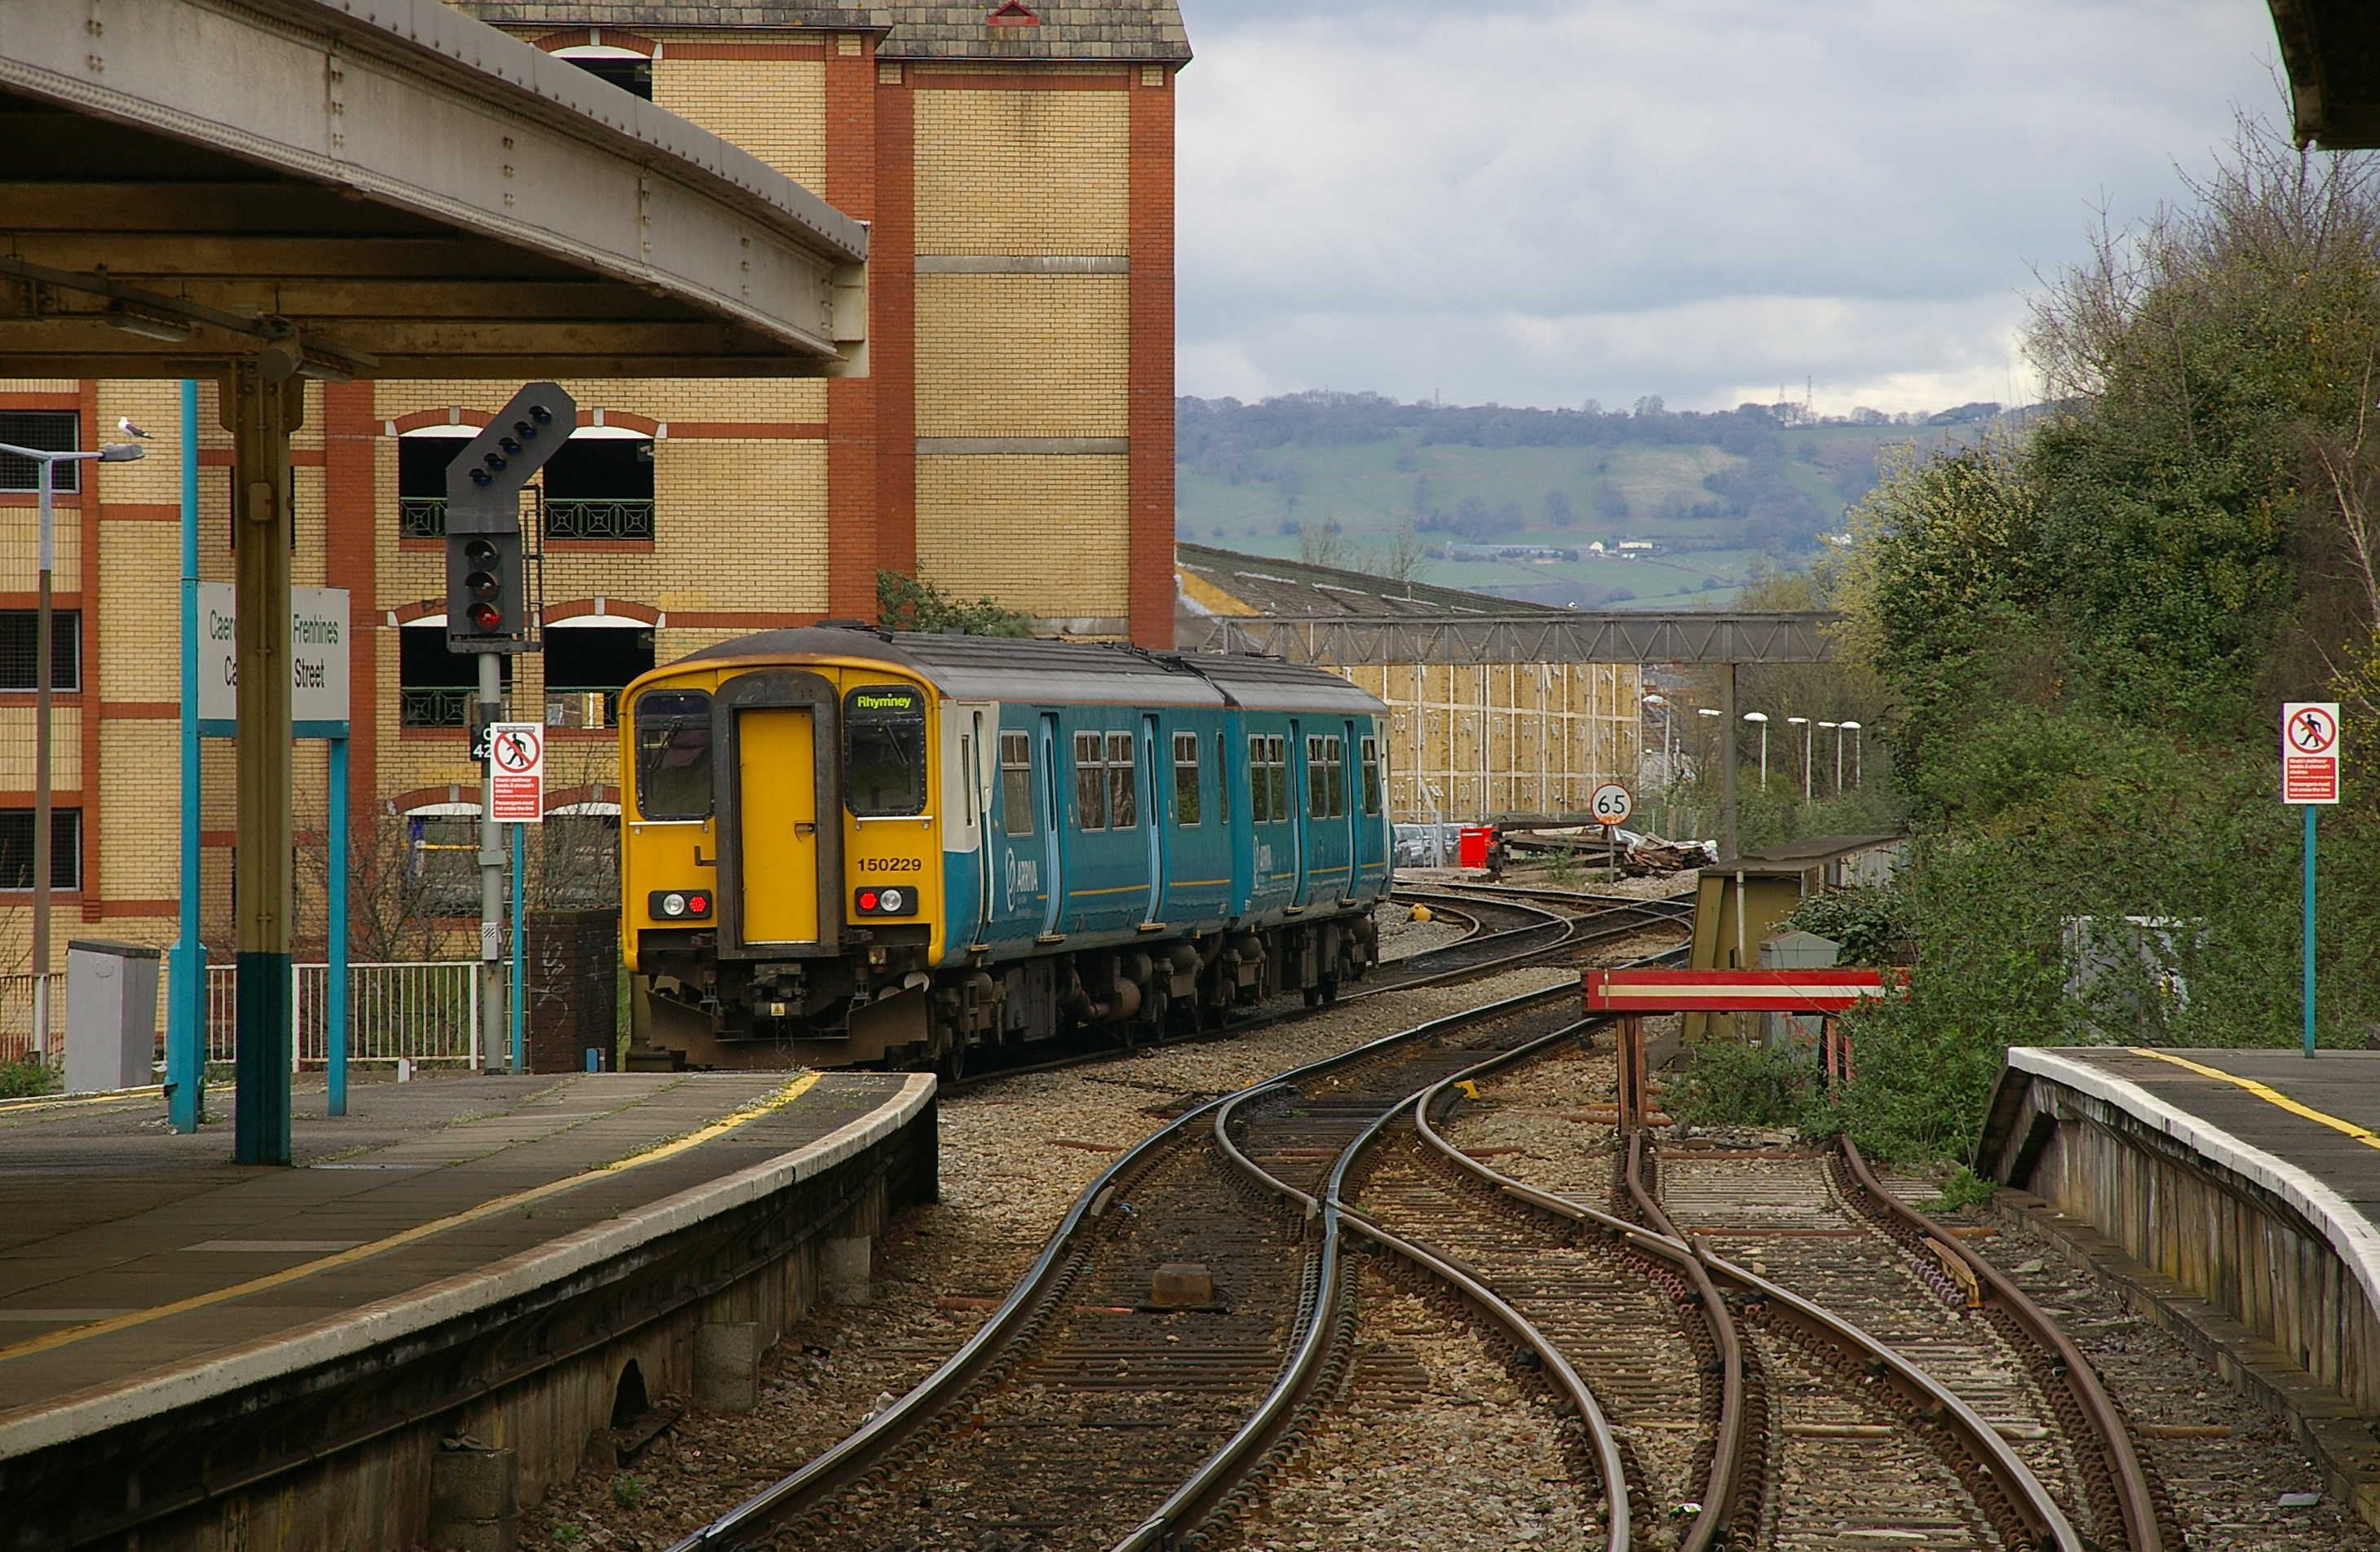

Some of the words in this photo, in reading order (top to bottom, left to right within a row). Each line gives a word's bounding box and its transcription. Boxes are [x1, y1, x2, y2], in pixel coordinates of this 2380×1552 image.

[210, 609, 237, 641] Caer
[293, 613, 338, 644] Frenhines
[294, 657, 325, 688] Street
[857, 696, 912, 710] Rhymney
[1598, 794, 1626, 814] 65
[856, 857, 922, 872] 150229
